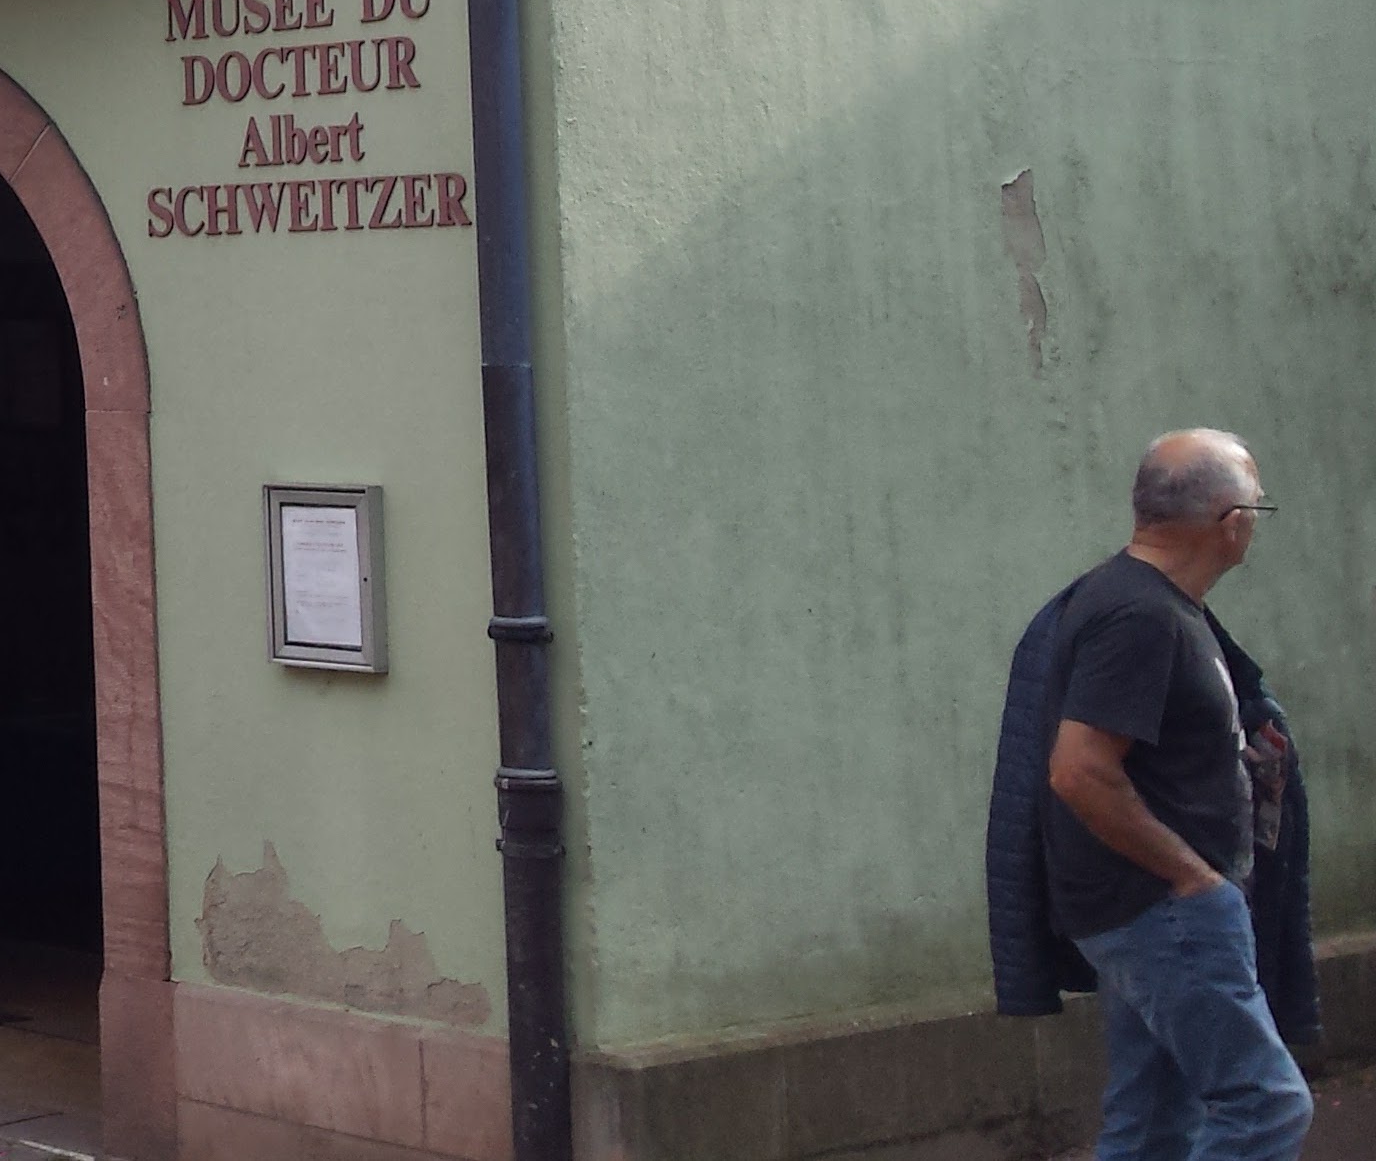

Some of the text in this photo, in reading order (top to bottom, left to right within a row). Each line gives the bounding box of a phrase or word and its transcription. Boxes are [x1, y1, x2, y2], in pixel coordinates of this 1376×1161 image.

[180, 36, 422, 106] DOCTEUR
[238, 112, 366, 168] Albert
[147, 172, 473, 238] SCHWEITZER
